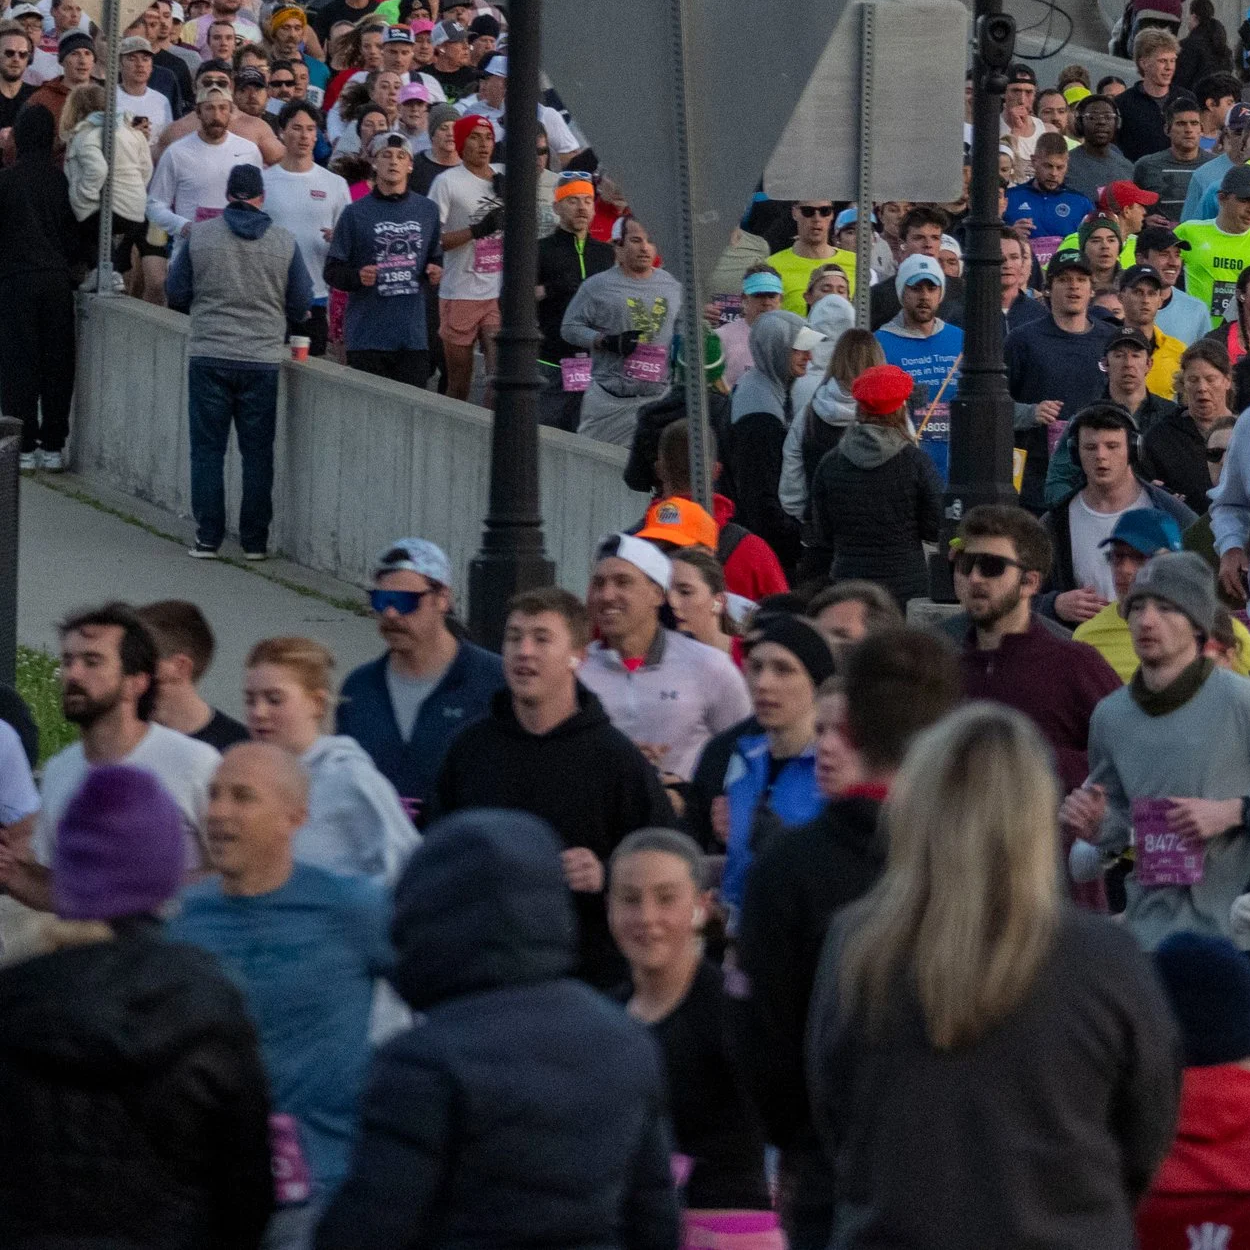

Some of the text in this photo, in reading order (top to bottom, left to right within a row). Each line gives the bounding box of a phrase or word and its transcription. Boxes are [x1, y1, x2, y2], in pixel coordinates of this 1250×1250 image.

[1213, 257, 1244, 270] DIEGO
[384, 271, 412, 283] 1369
[901, 356, 932, 366] Donald
[922, 422, 950, 432] 803
